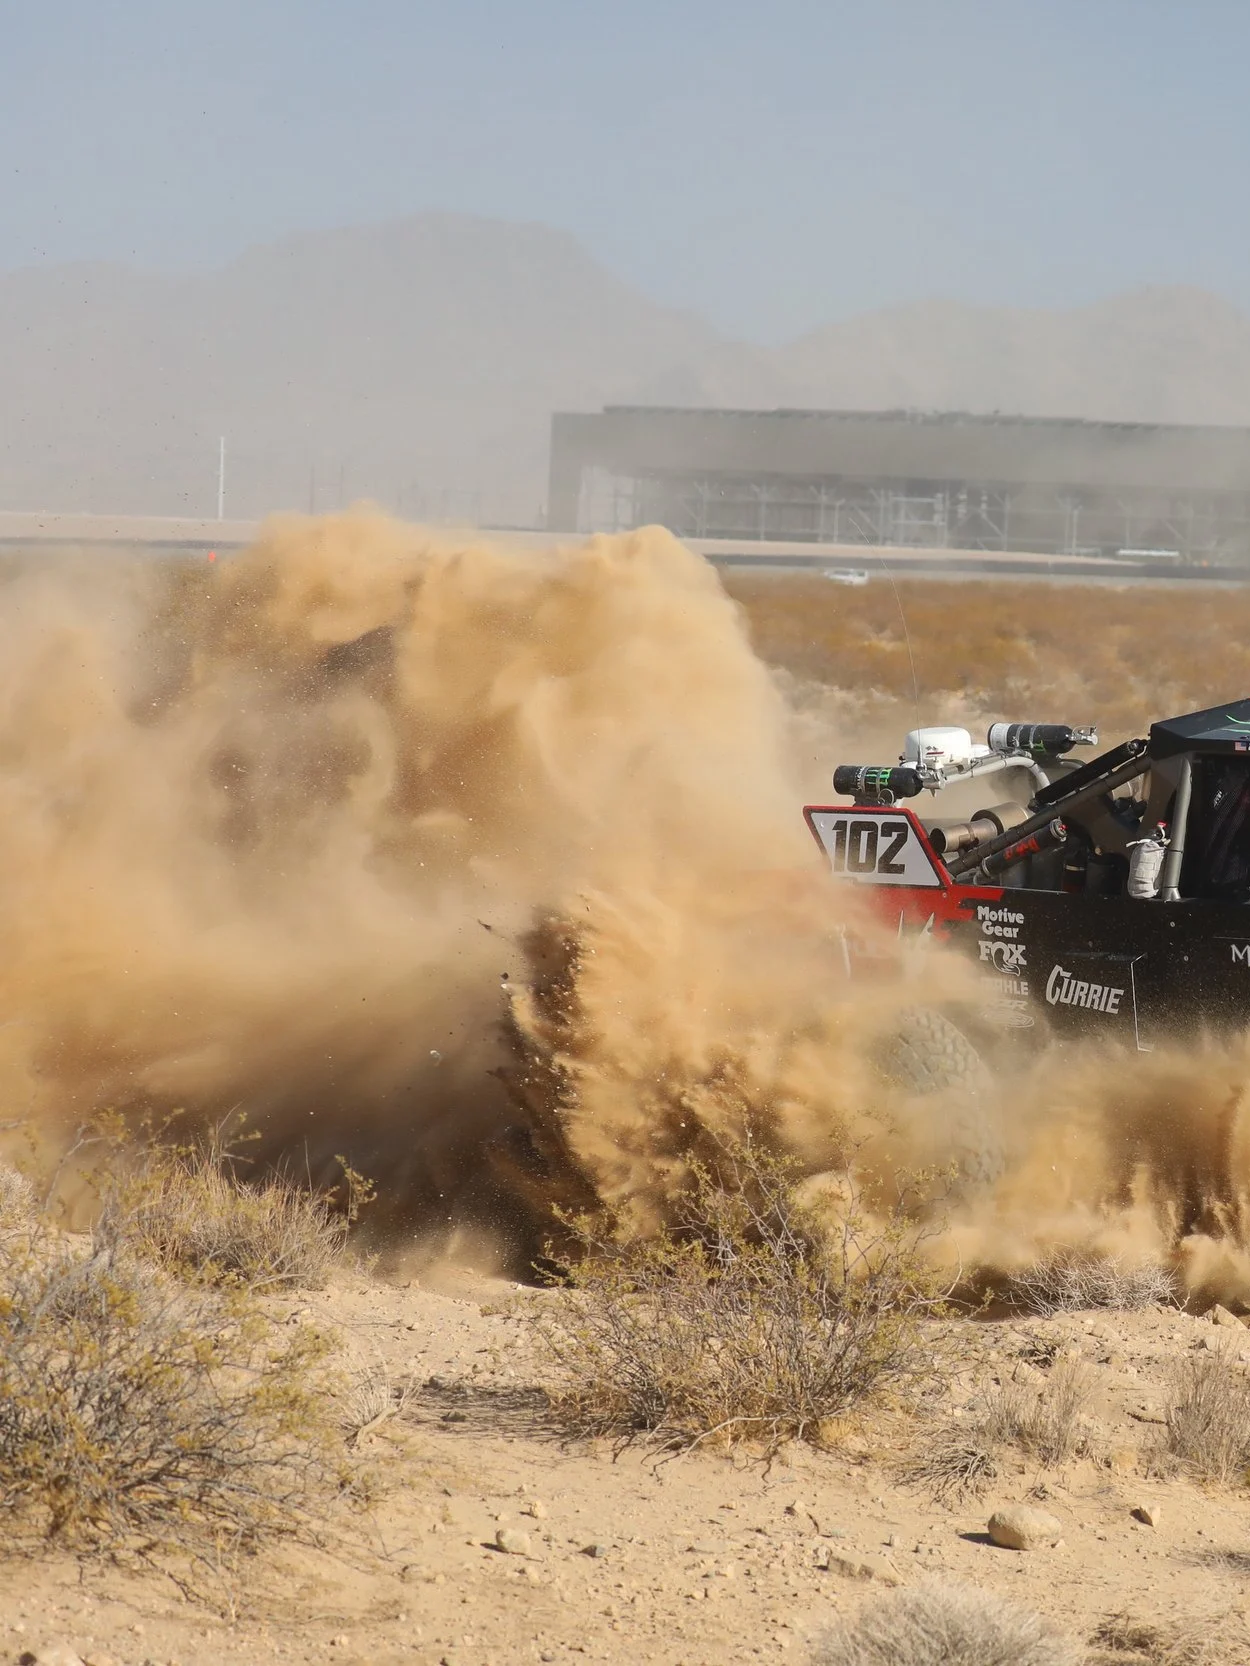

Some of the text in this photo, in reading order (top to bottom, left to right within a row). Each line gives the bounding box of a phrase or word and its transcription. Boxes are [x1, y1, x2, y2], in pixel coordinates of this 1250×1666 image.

[832, 820, 908, 874] 102
[977, 906, 1025, 924] Motive
[982, 921, 1019, 938] Gear
[978, 940, 1027, 975] FOX
[1045, 964, 1125, 1015] CURRIE
